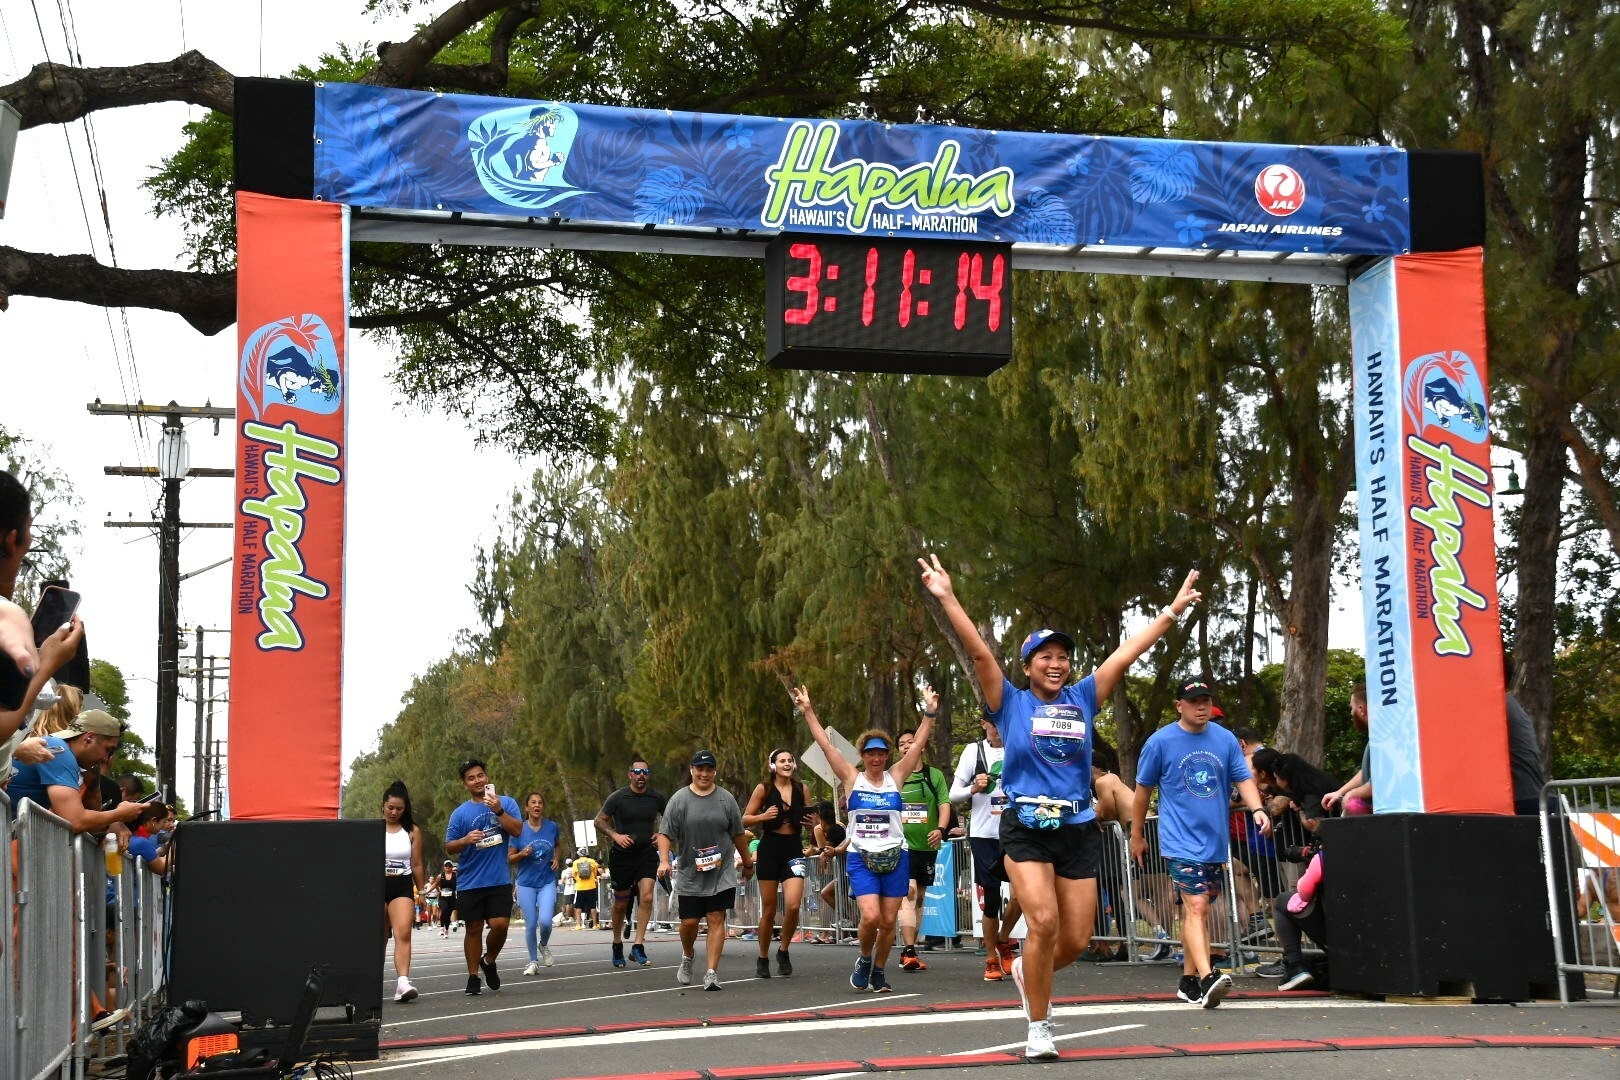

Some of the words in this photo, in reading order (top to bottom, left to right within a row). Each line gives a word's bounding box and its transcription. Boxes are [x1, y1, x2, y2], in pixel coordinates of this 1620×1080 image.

[762, 121, 1014, 233] Hapalua
[1269, 200, 1296, 210] JAL
[789, 208, 845, 227] HAWAII'S
[872, 214, 978, 233] HALF-MARATHON
[1218, 223, 1268, 234] JAPAN
[1270, 224, 1343, 237] AIRLINES
[1367, 351, 1385, 465] HAWAII'S
[243, 444, 259, 495] HAWAII'S
[1410, 456, 1423, 504] HAWAII'S
[239, 421, 342, 652] Hapalua
[243, 520, 258, 549] HALF
[1370, 475, 1389, 543] HALF
[1407, 434, 1491, 658] Hapalua
[1411, 527, 1425, 554] HALF
[239, 553, 257, 614] MARATHON
[1413, 558, 1429, 619] MARATHON
[1374, 555, 1397, 707] MARATHON
[1050, 720, 1072, 730] 7089
